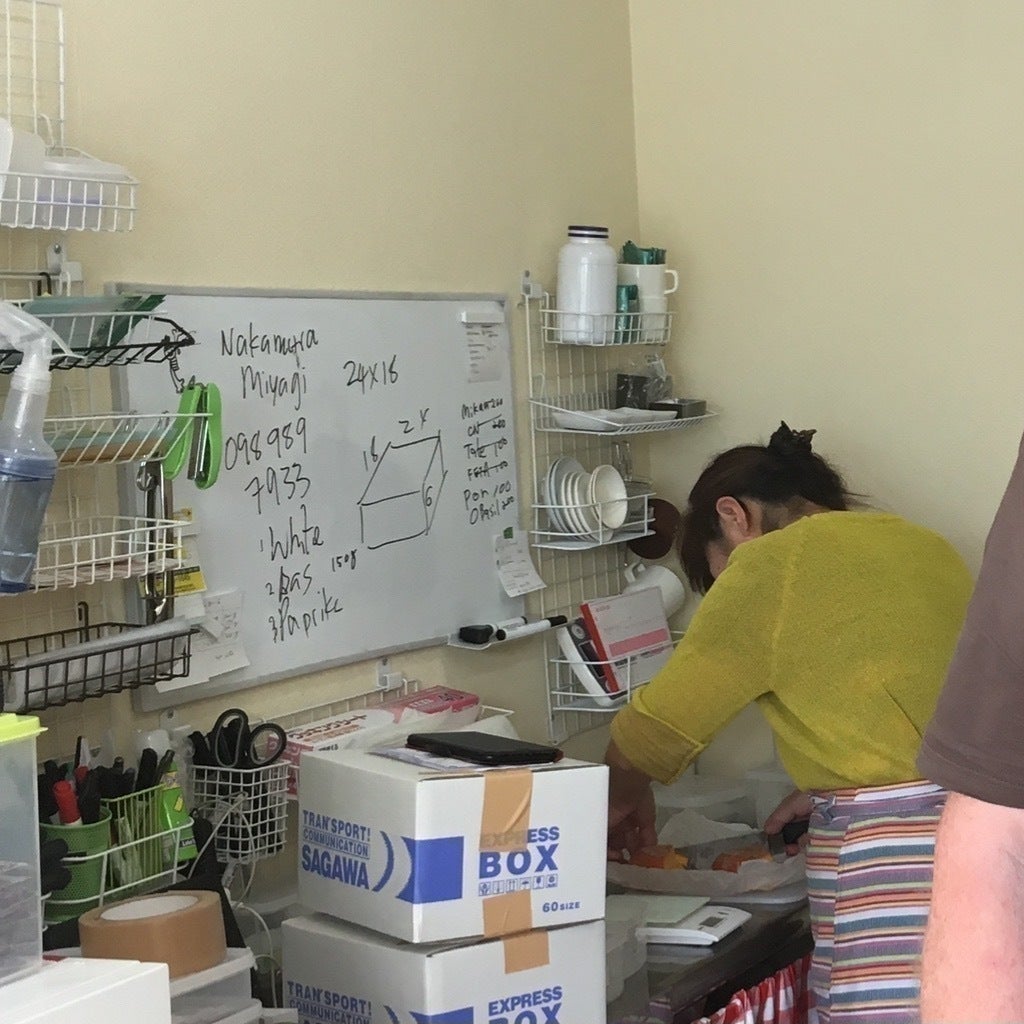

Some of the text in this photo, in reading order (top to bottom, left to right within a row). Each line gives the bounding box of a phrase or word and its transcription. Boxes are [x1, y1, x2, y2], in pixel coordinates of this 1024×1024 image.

[241, 365, 307, 411] Miyagi
[244, 463, 311, 515] 7933
[302, 828, 369, 857] COMMUNICATION
[478, 843, 560, 880] BOX
[301, 844, 370, 891] SAGAWA
[488, 986, 563, 1016] EXPRESS
